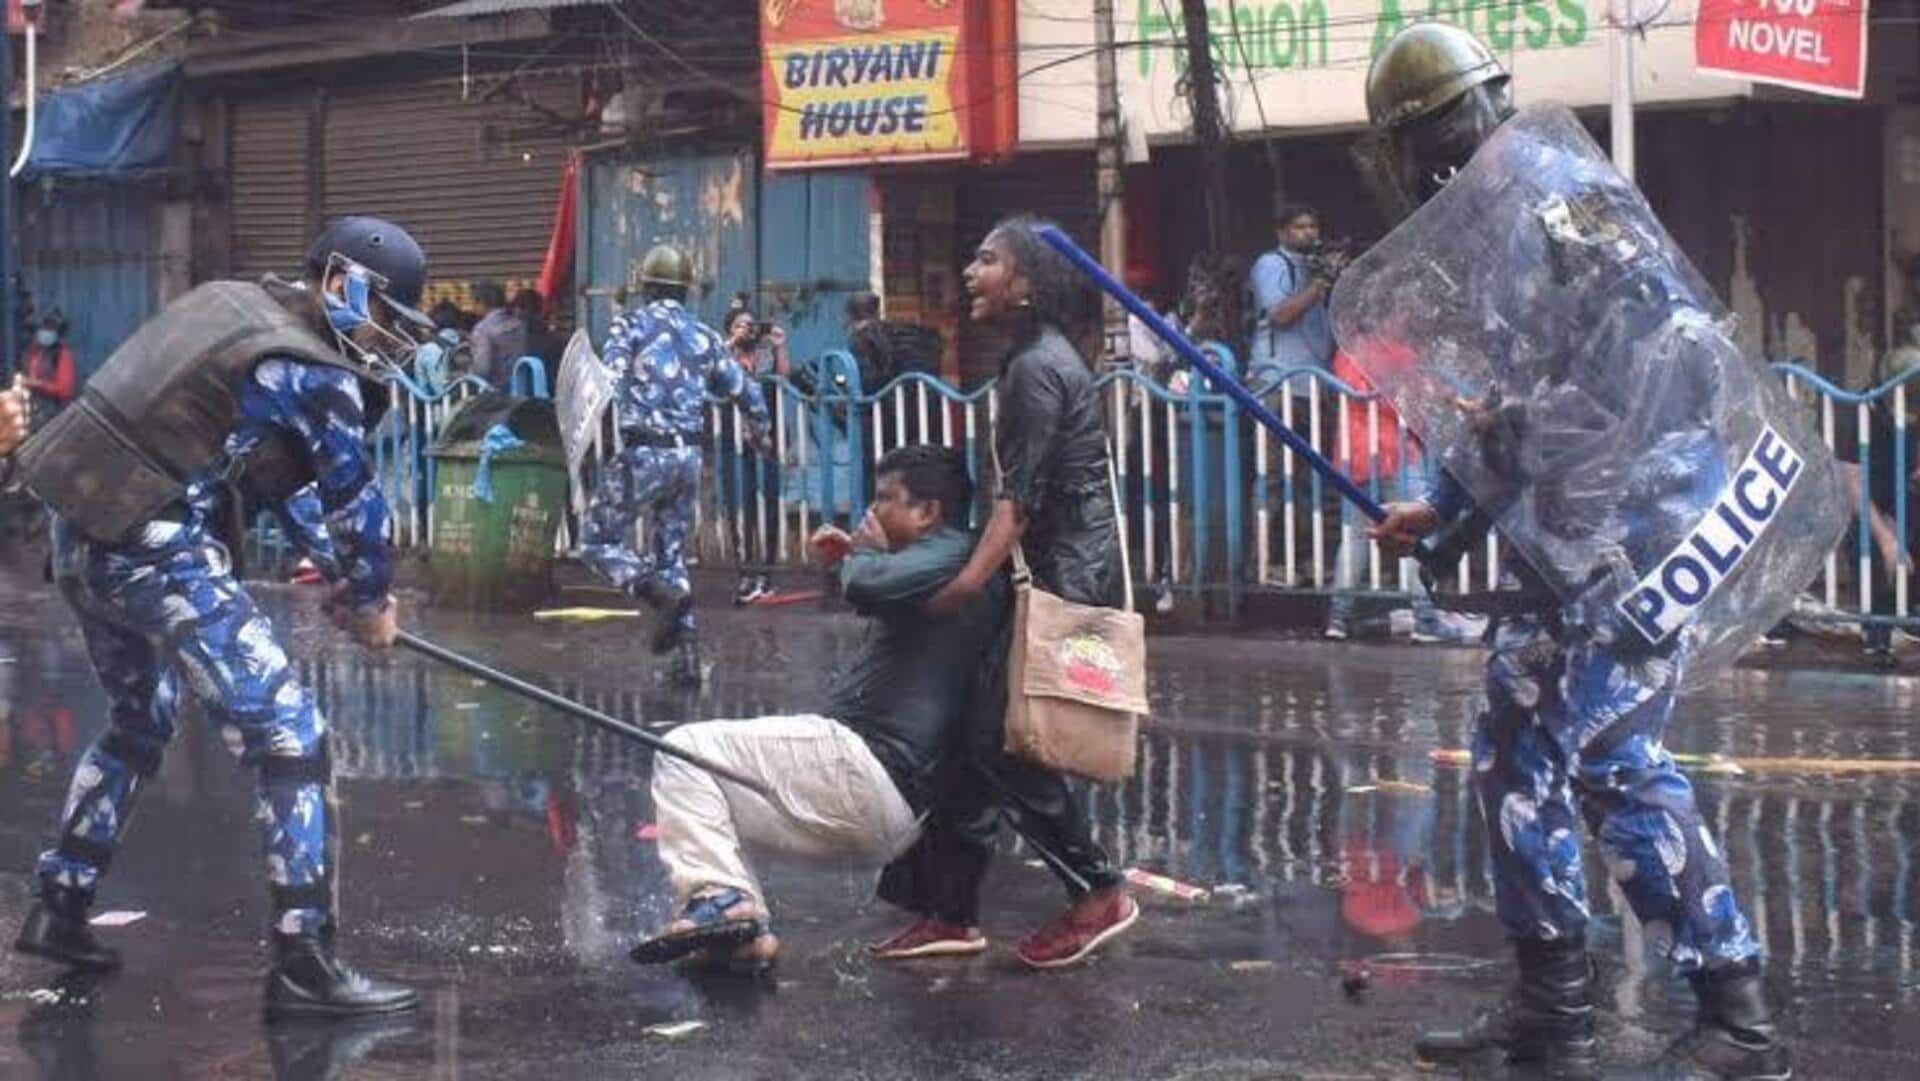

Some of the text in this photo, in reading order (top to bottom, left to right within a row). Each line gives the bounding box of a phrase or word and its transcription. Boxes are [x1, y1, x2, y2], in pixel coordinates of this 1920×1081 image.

[1728, 18, 1831, 64] NOVEL
[783, 41, 942, 89] BIRYANI
[800, 95, 927, 140] HOUSE
[1620, 430, 1801, 640] POLICE
